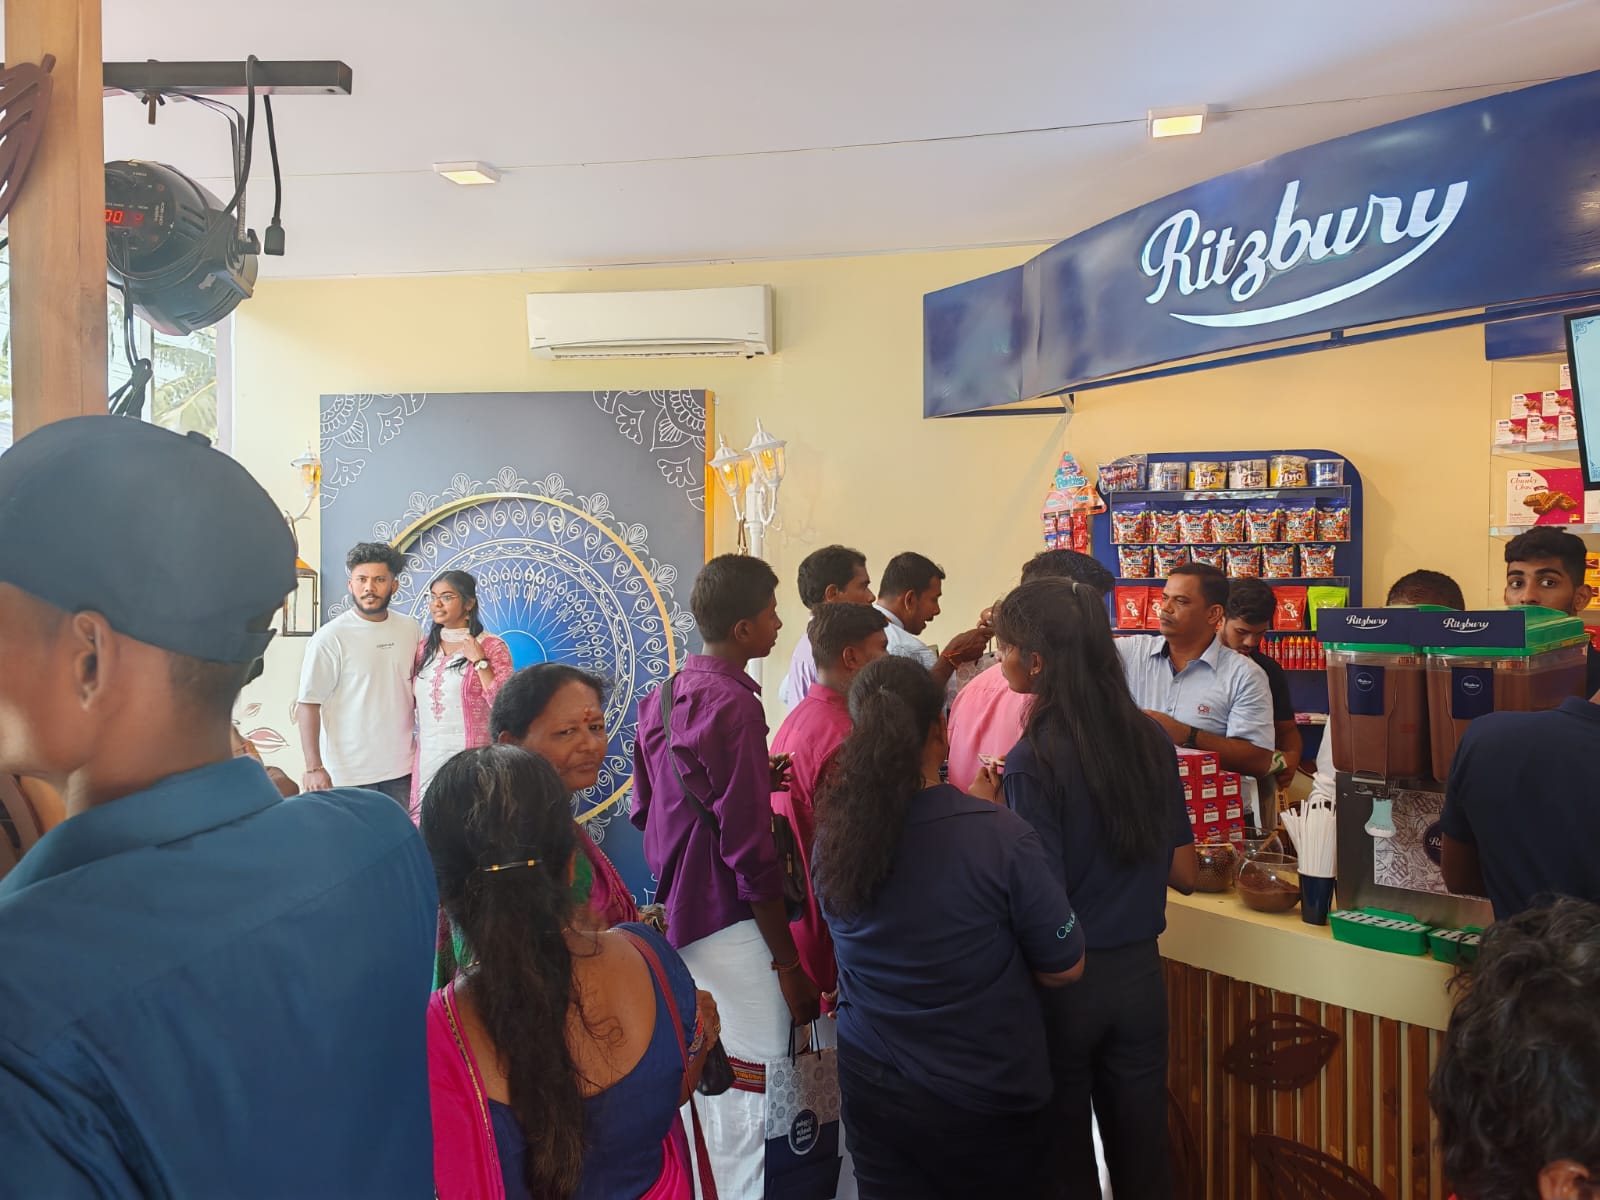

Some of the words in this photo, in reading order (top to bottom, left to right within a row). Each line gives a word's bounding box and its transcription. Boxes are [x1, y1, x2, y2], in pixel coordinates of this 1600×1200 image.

[1141, 180, 1469, 328] Ritzbury
[1345, 614, 1388, 630] Ritzbury
[1442, 617, 1489, 633] Ritzbury
